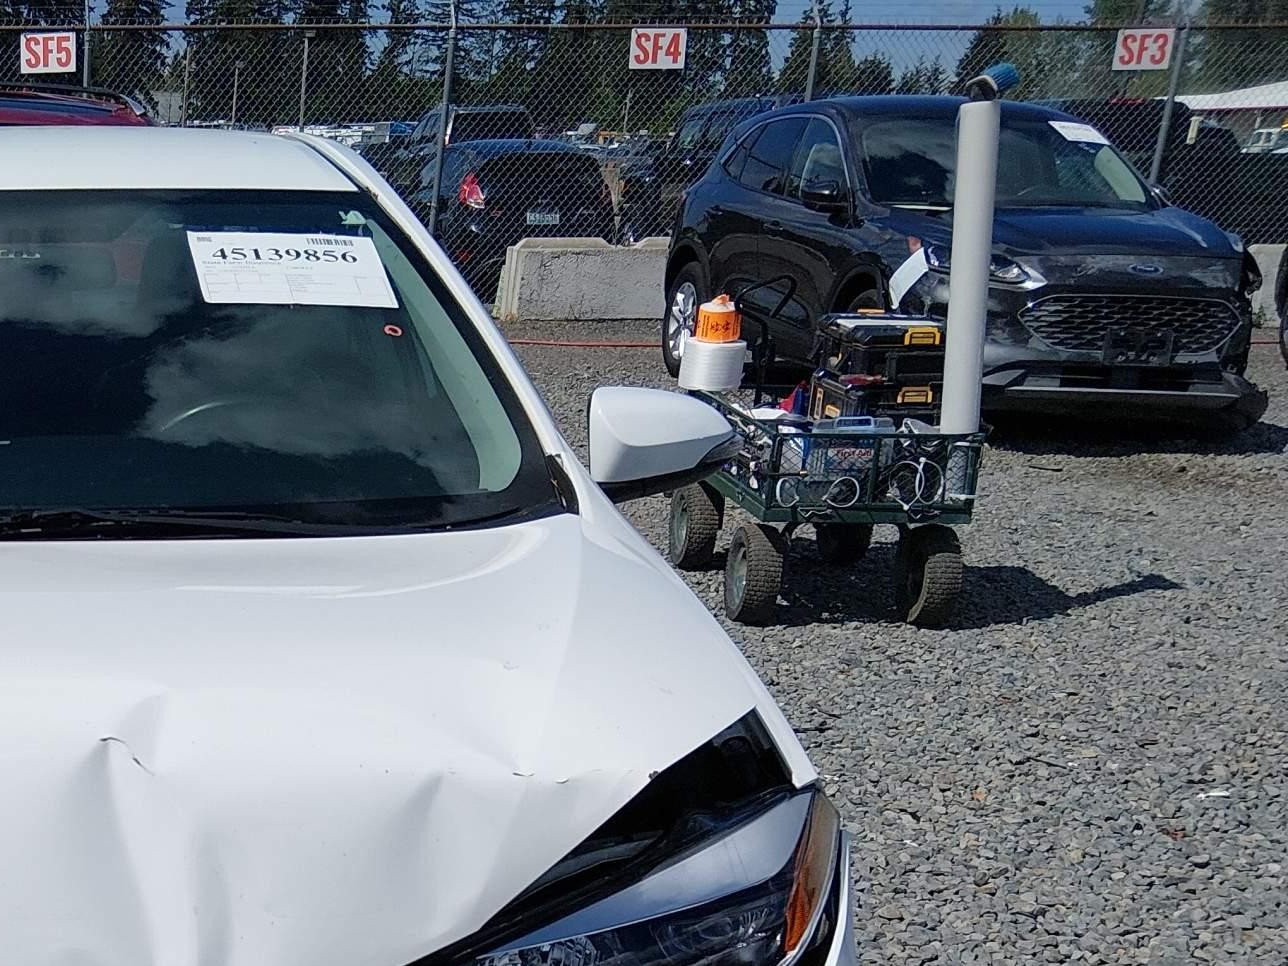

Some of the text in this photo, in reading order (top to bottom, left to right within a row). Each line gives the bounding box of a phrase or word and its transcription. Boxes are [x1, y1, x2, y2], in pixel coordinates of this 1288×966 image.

[25, 36, 72, 69] SF5
[634, 32, 681, 65] SF4
[1118, 33, 1168, 65] SF3
[212, 247, 358, 264] 45139856
